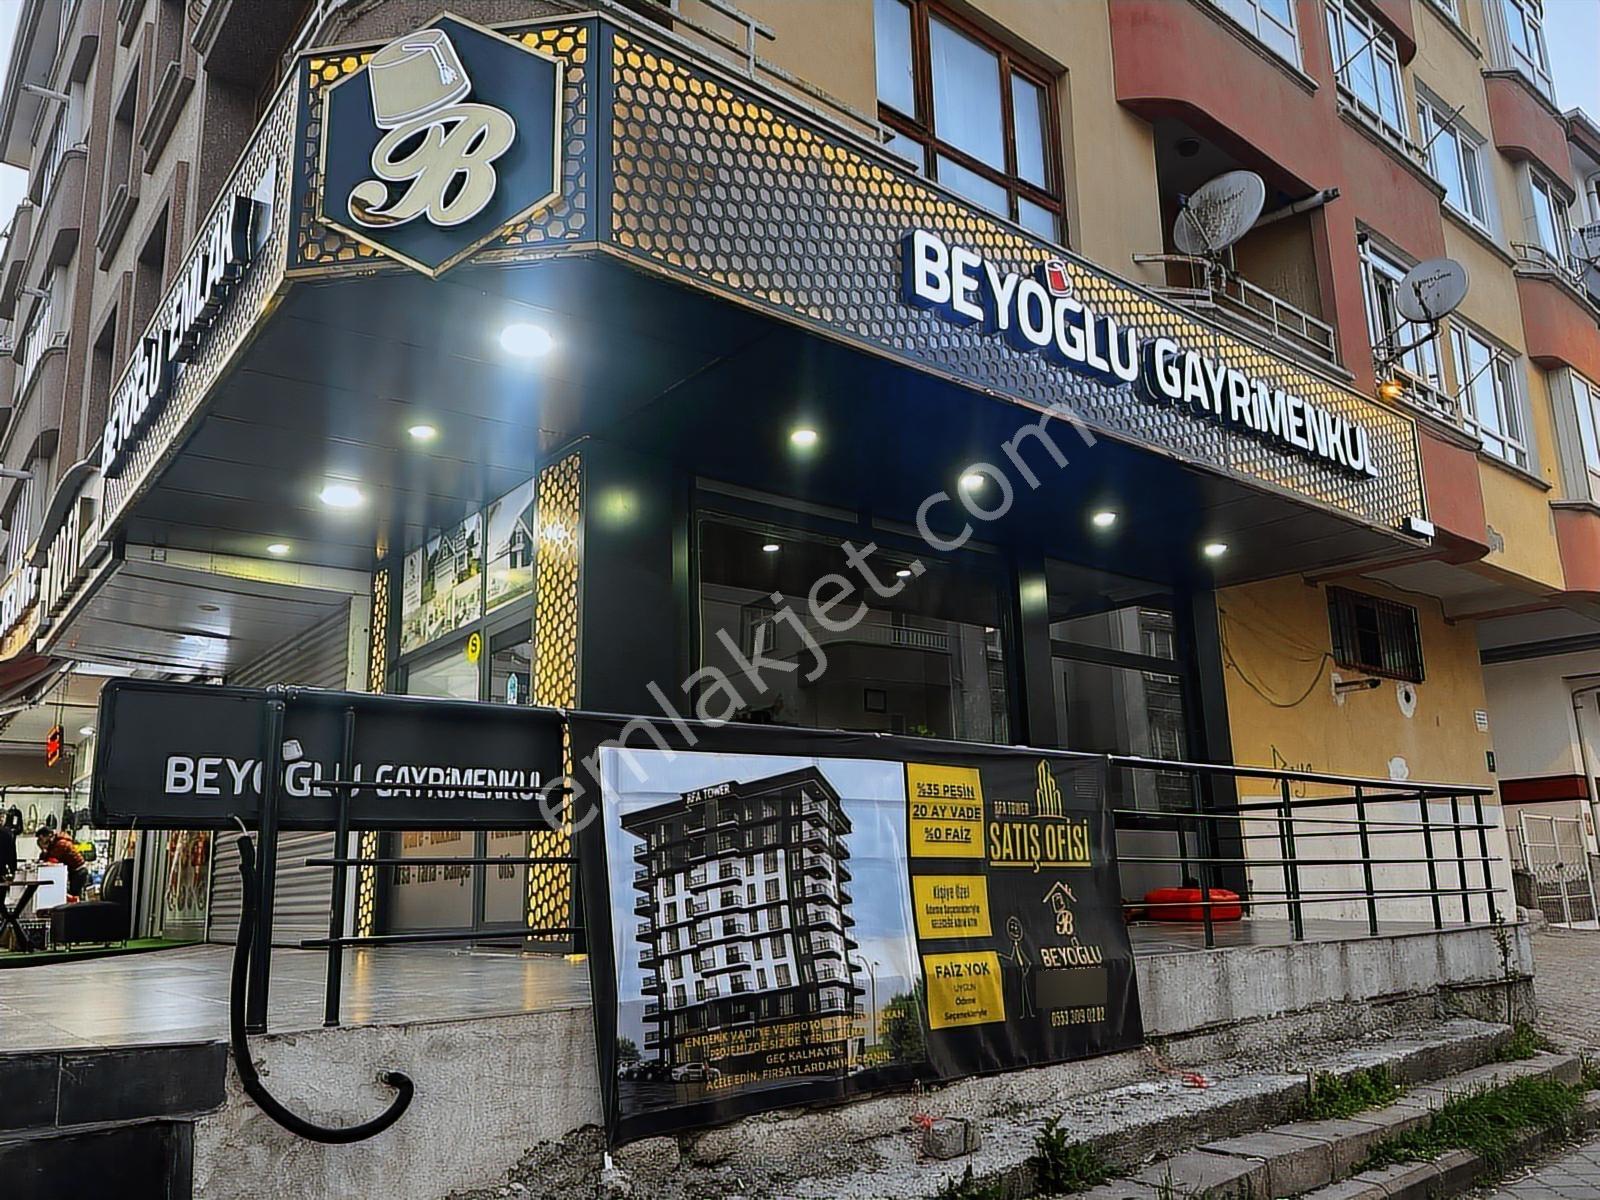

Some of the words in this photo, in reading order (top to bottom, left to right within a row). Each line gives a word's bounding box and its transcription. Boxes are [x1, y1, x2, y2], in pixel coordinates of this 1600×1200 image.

[913, 804, 927, 817] 20
[931, 805, 947, 817] AY
[950, 806, 981, 819] VADE
[945, 825, 972, 841] FAİZ
[990, 821, 1041, 873] SATIŞ
[1045, 817, 1092, 861] OFİSİ
[935, 961, 963, 979] FAİZ
[964, 961, 990, 977] YOK
